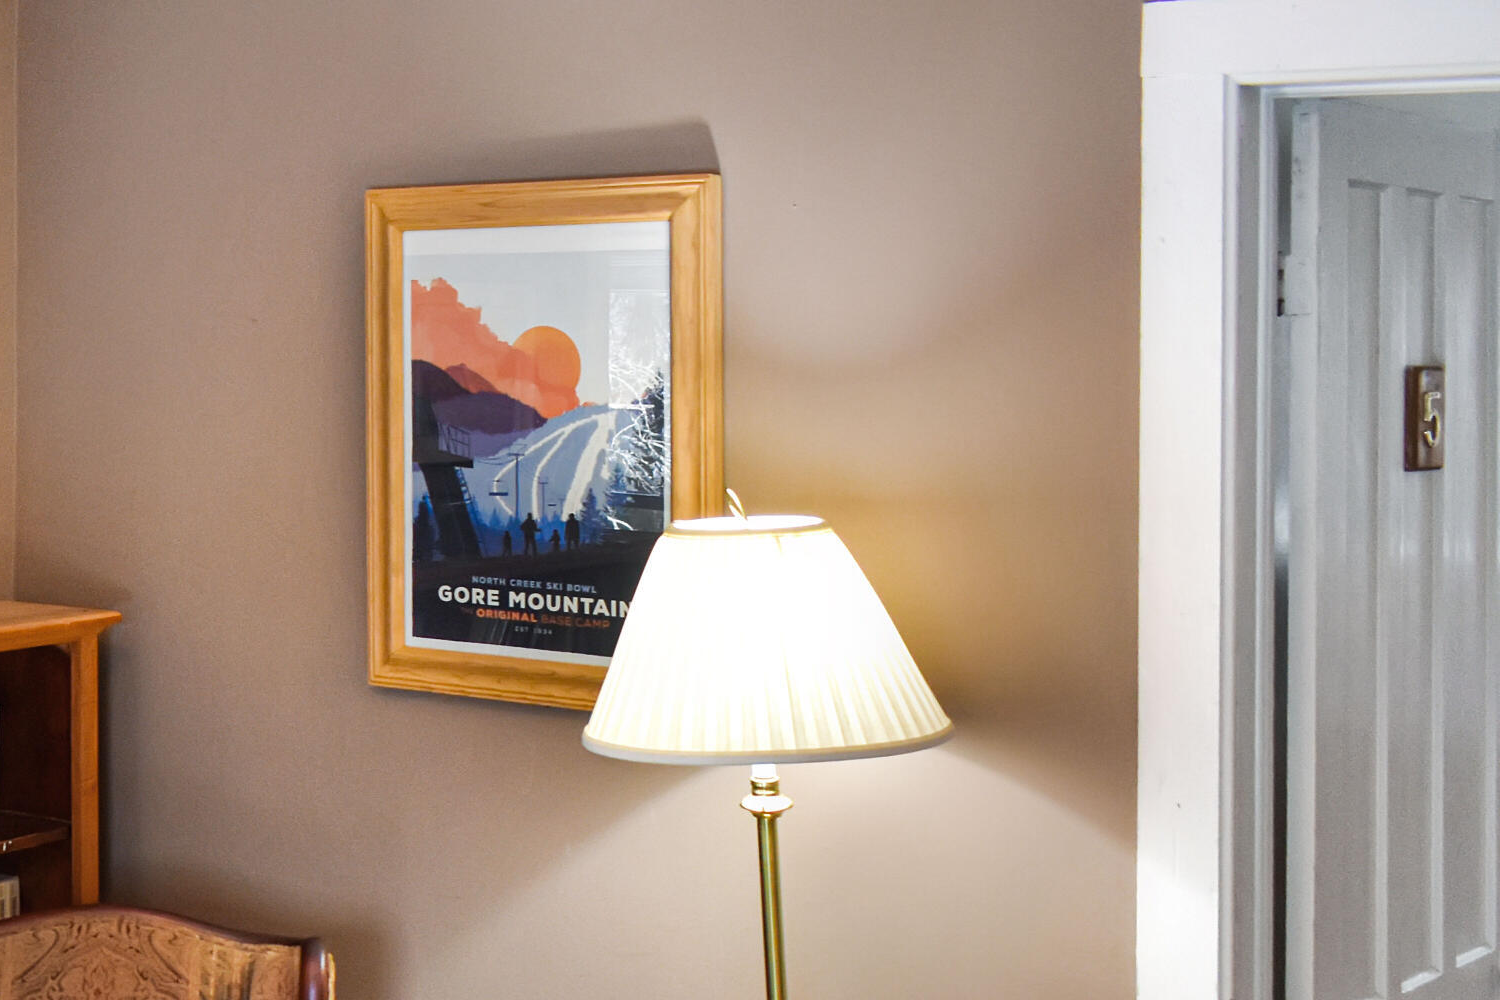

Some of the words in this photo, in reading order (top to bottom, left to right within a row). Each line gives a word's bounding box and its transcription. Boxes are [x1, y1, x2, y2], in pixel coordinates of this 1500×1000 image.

[472, 575, 507, 587] NORTH
[509, 578, 542, 589] CREEK
[546, 581, 563, 591] SKI
[566, 583, 597, 594] BOWL
[437, 585, 500, 607] GORE
[475, 607, 538, 623] ORIGINAL
[541, 614, 572, 628] BASE
[575, 616, 610, 629] CAMP
